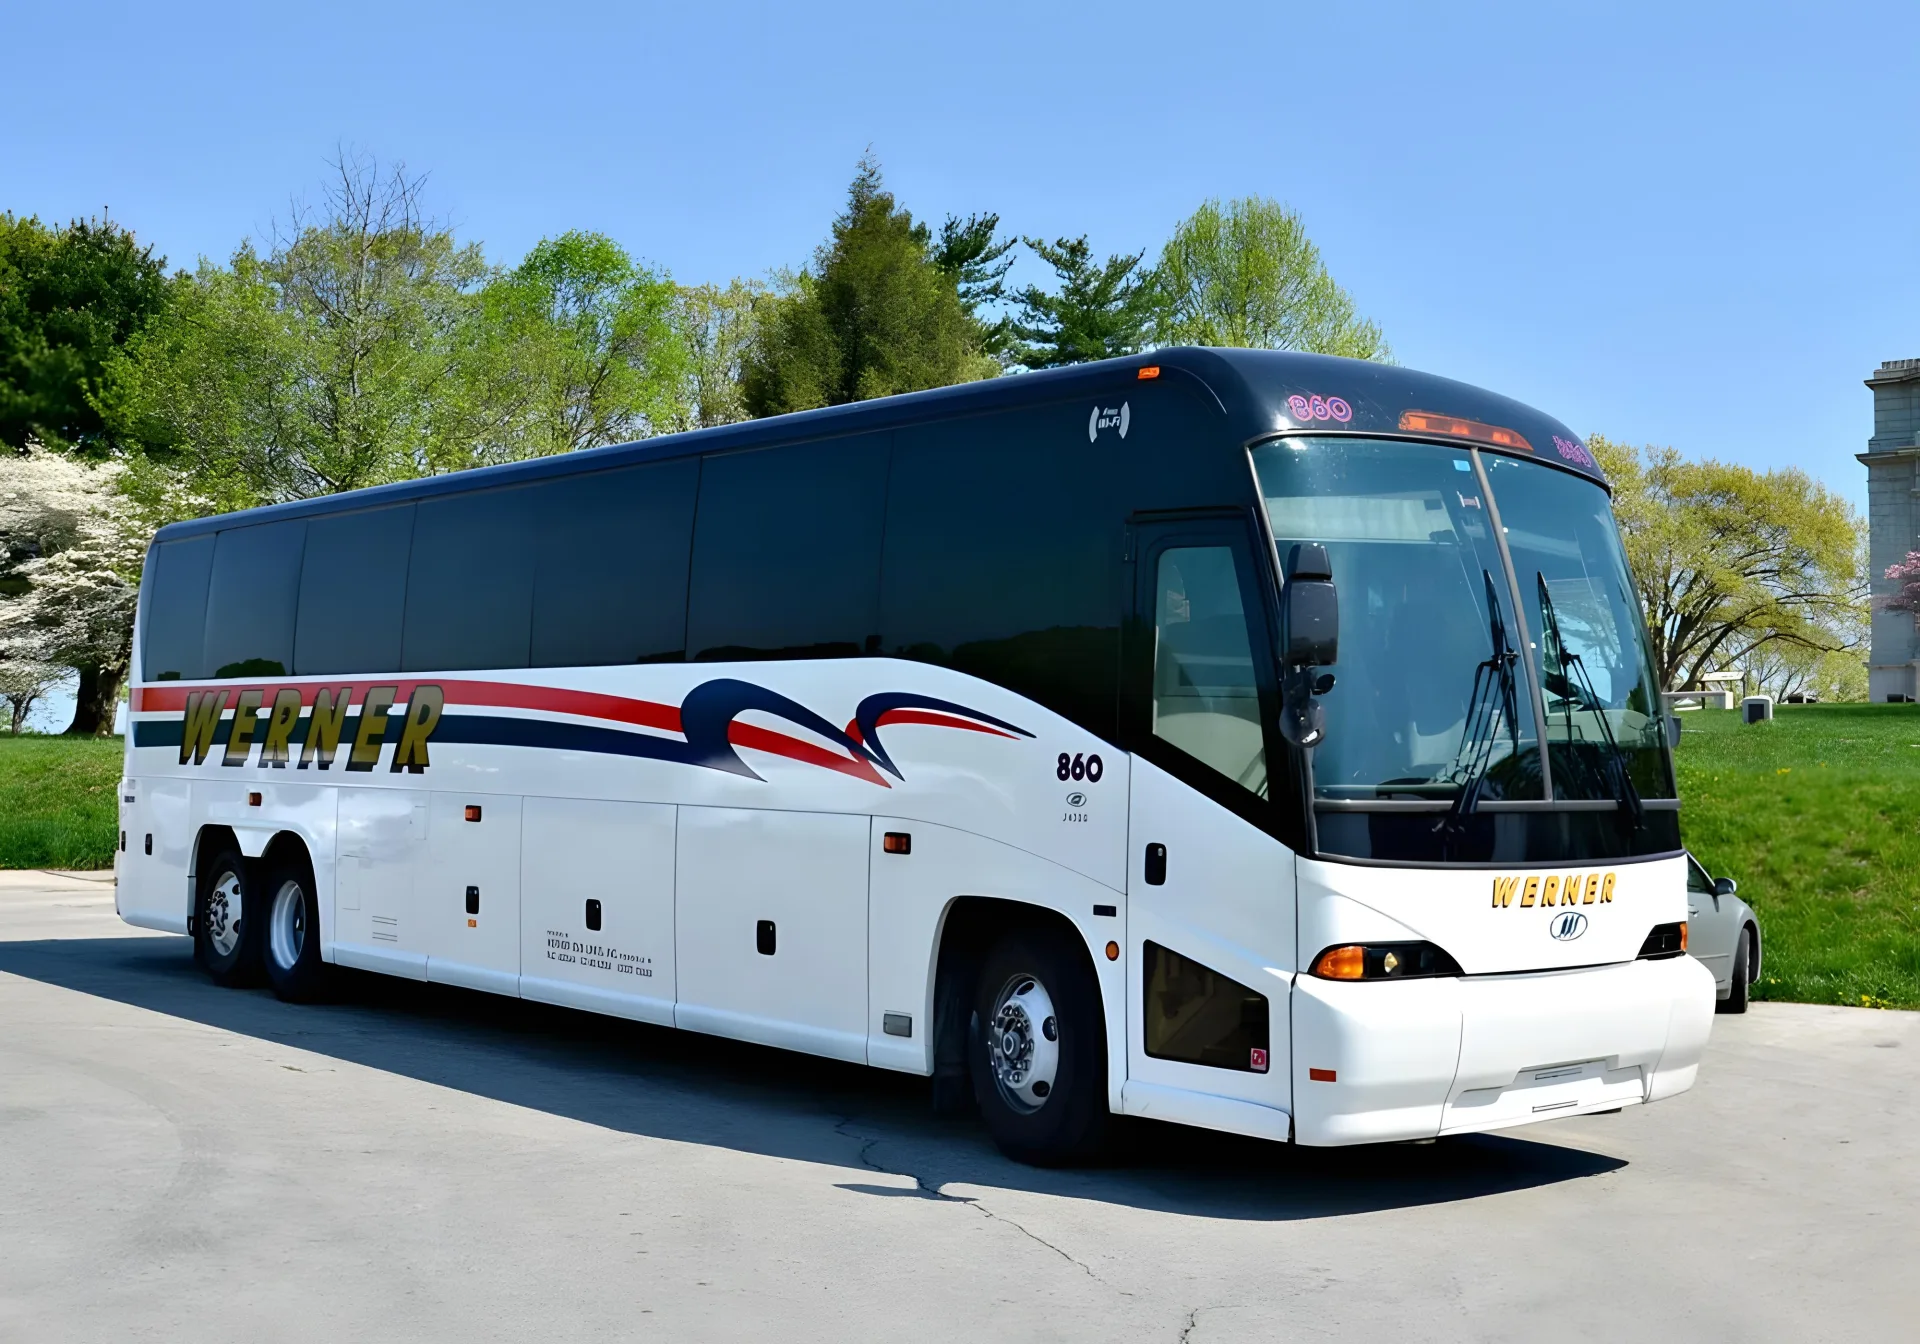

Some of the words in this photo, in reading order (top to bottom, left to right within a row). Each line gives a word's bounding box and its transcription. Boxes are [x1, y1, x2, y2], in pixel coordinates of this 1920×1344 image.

[1288, 395, 1352, 422] 860
[179, 685, 444, 774] WERNER
[1057, 752, 1103, 783] 860
[1492, 872, 1616, 908] WERNER
